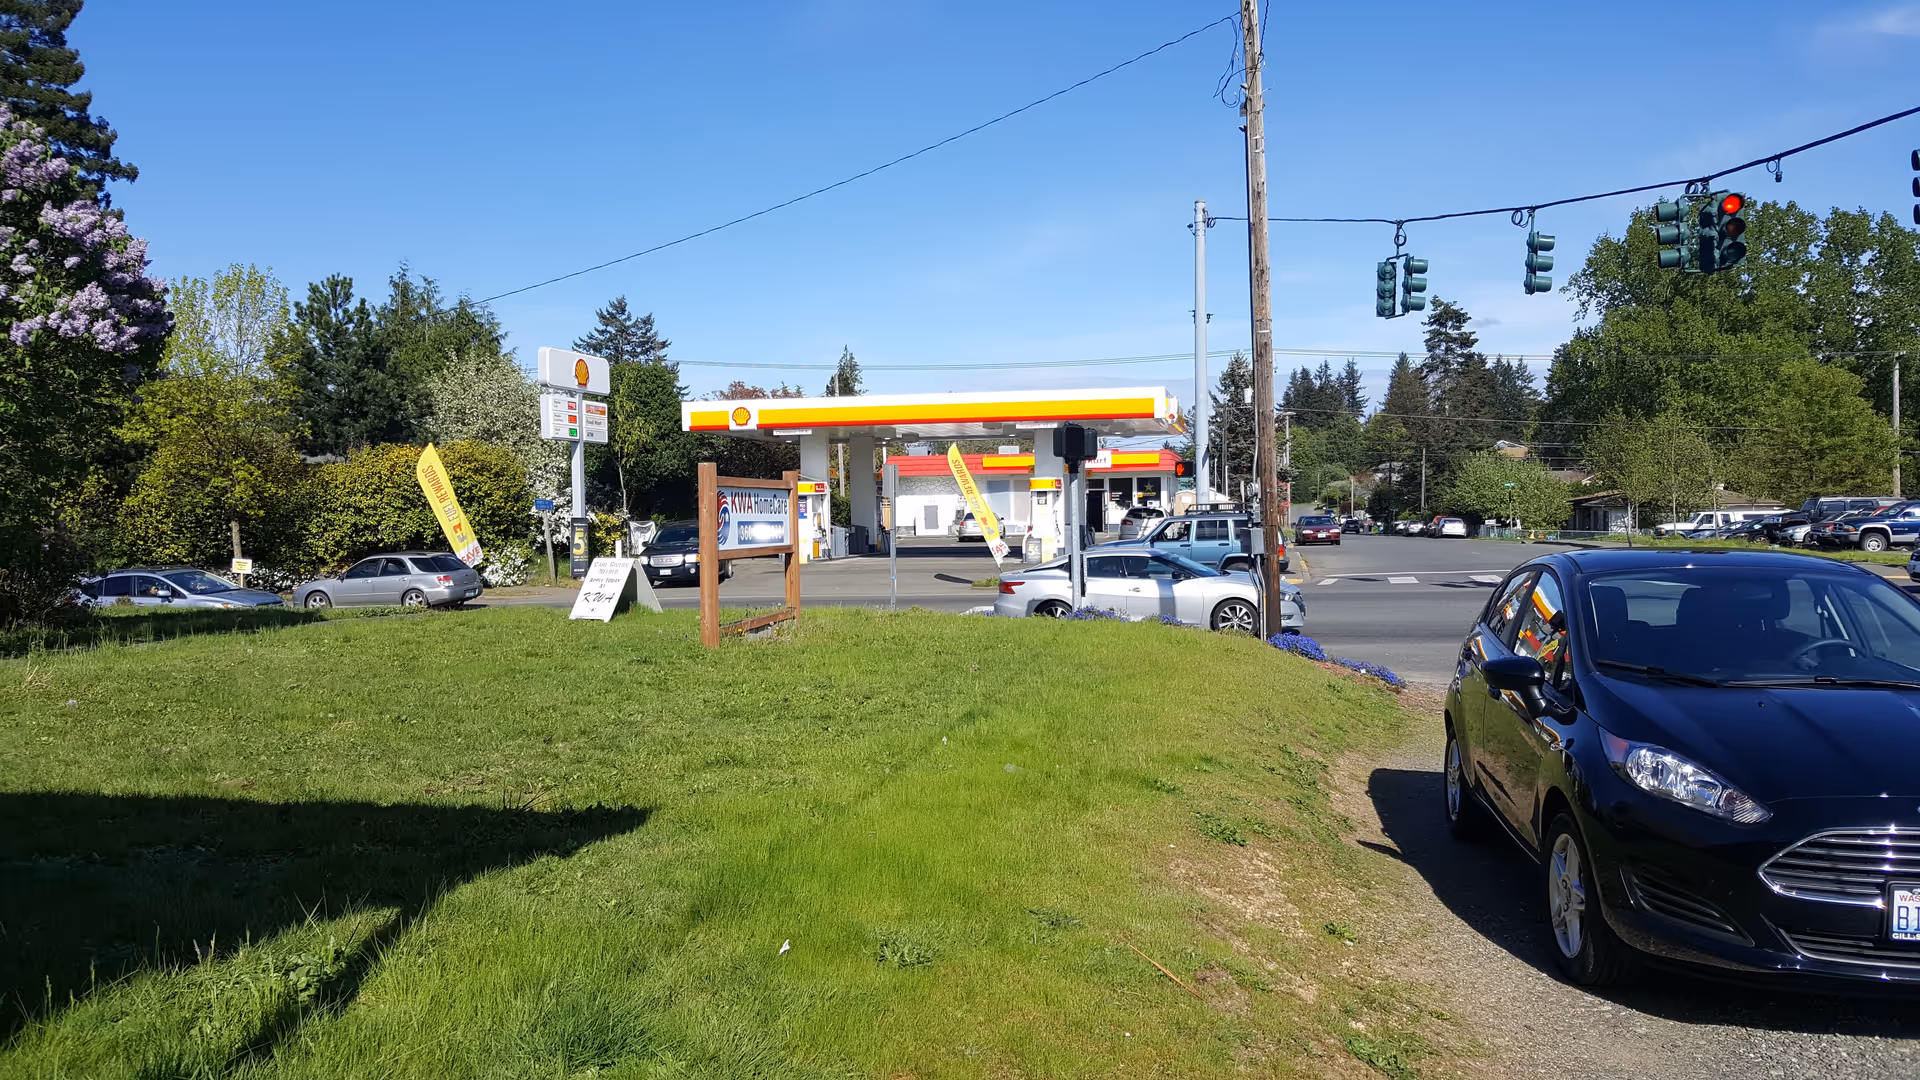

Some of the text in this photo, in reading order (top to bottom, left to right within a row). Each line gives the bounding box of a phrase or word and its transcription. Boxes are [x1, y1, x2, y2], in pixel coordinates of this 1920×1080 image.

[951, 459, 975, 495] REWARDS
[422, 464, 459, 522] REWARDS FUEL
[730, 491, 753, 514] KWA
[754, 493, 788, 515] HomeCare
[461, 546, 480, 563] SAVE
[582, 591, 615, 604] KWA
